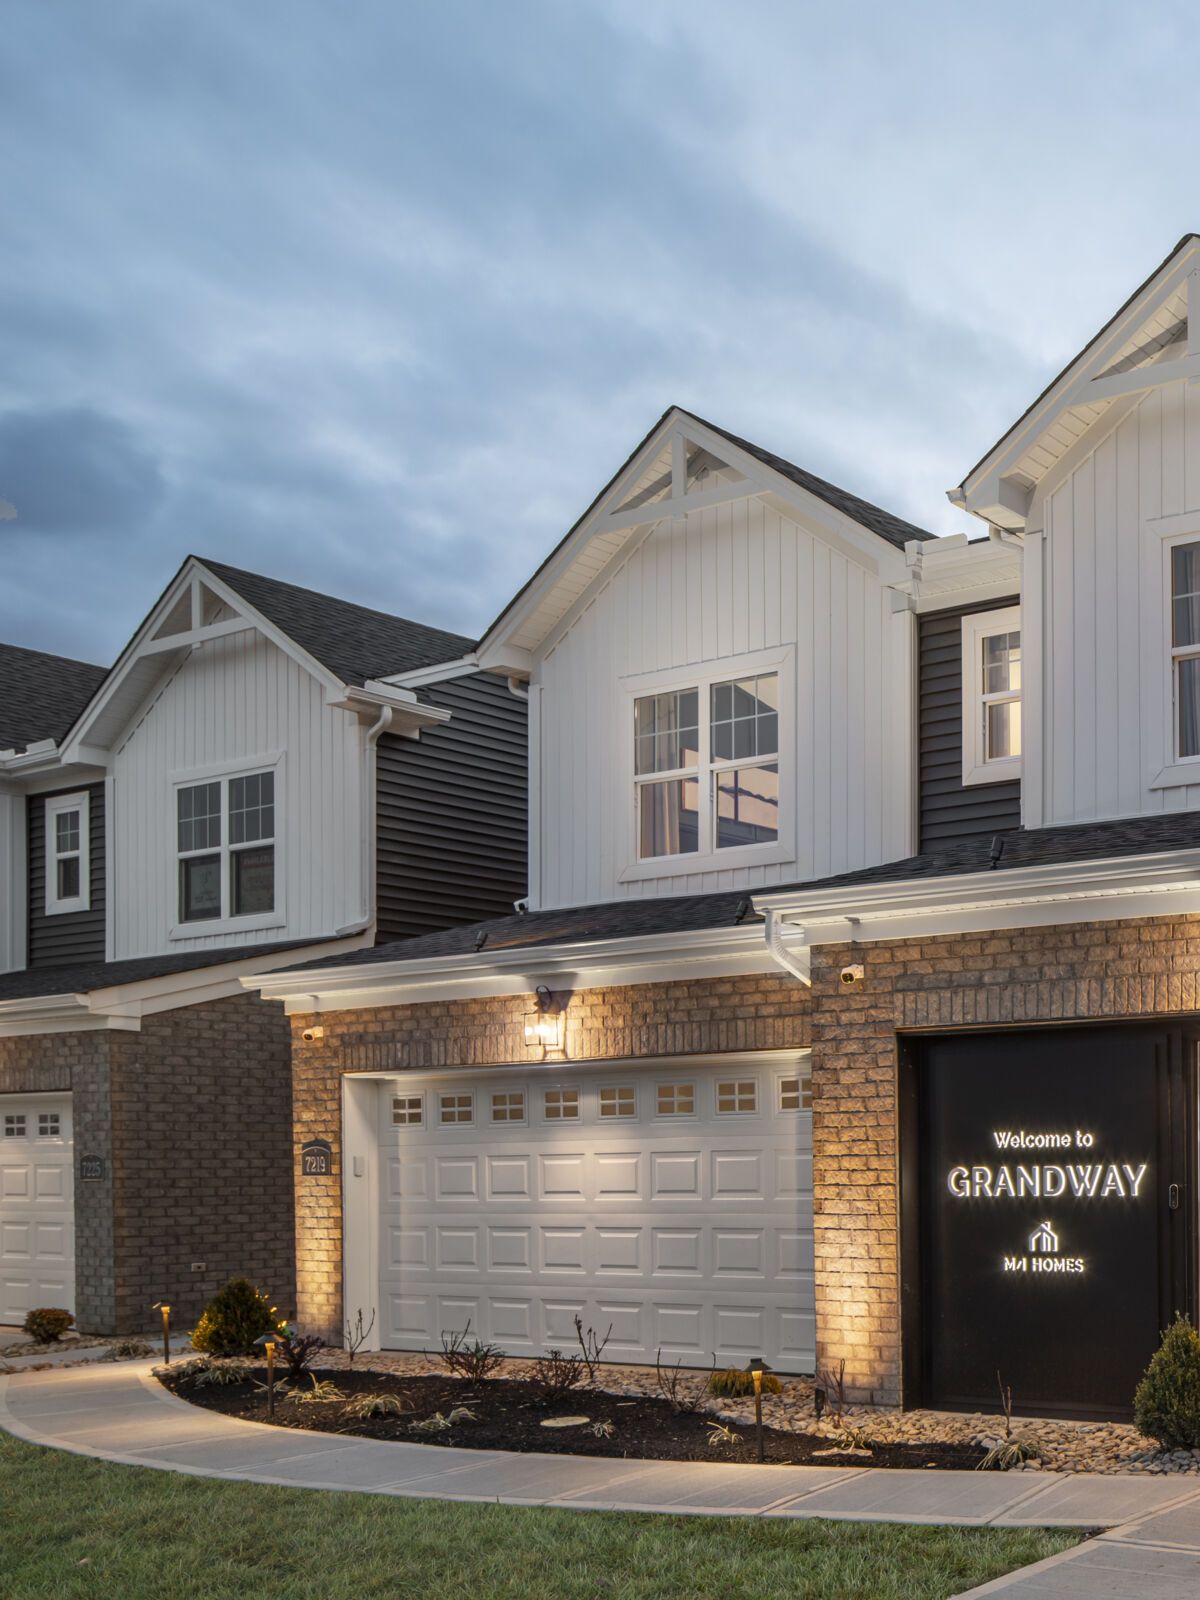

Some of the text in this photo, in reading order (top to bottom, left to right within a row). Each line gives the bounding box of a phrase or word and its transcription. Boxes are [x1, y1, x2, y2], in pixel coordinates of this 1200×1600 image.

[993, 1130, 1094, 1148] Welcome to
[305, 1156, 326, 1172] 7219
[947, 1164, 1147, 1197] GRANDWAY
[1032, 1258, 1085, 1273] HOMES
